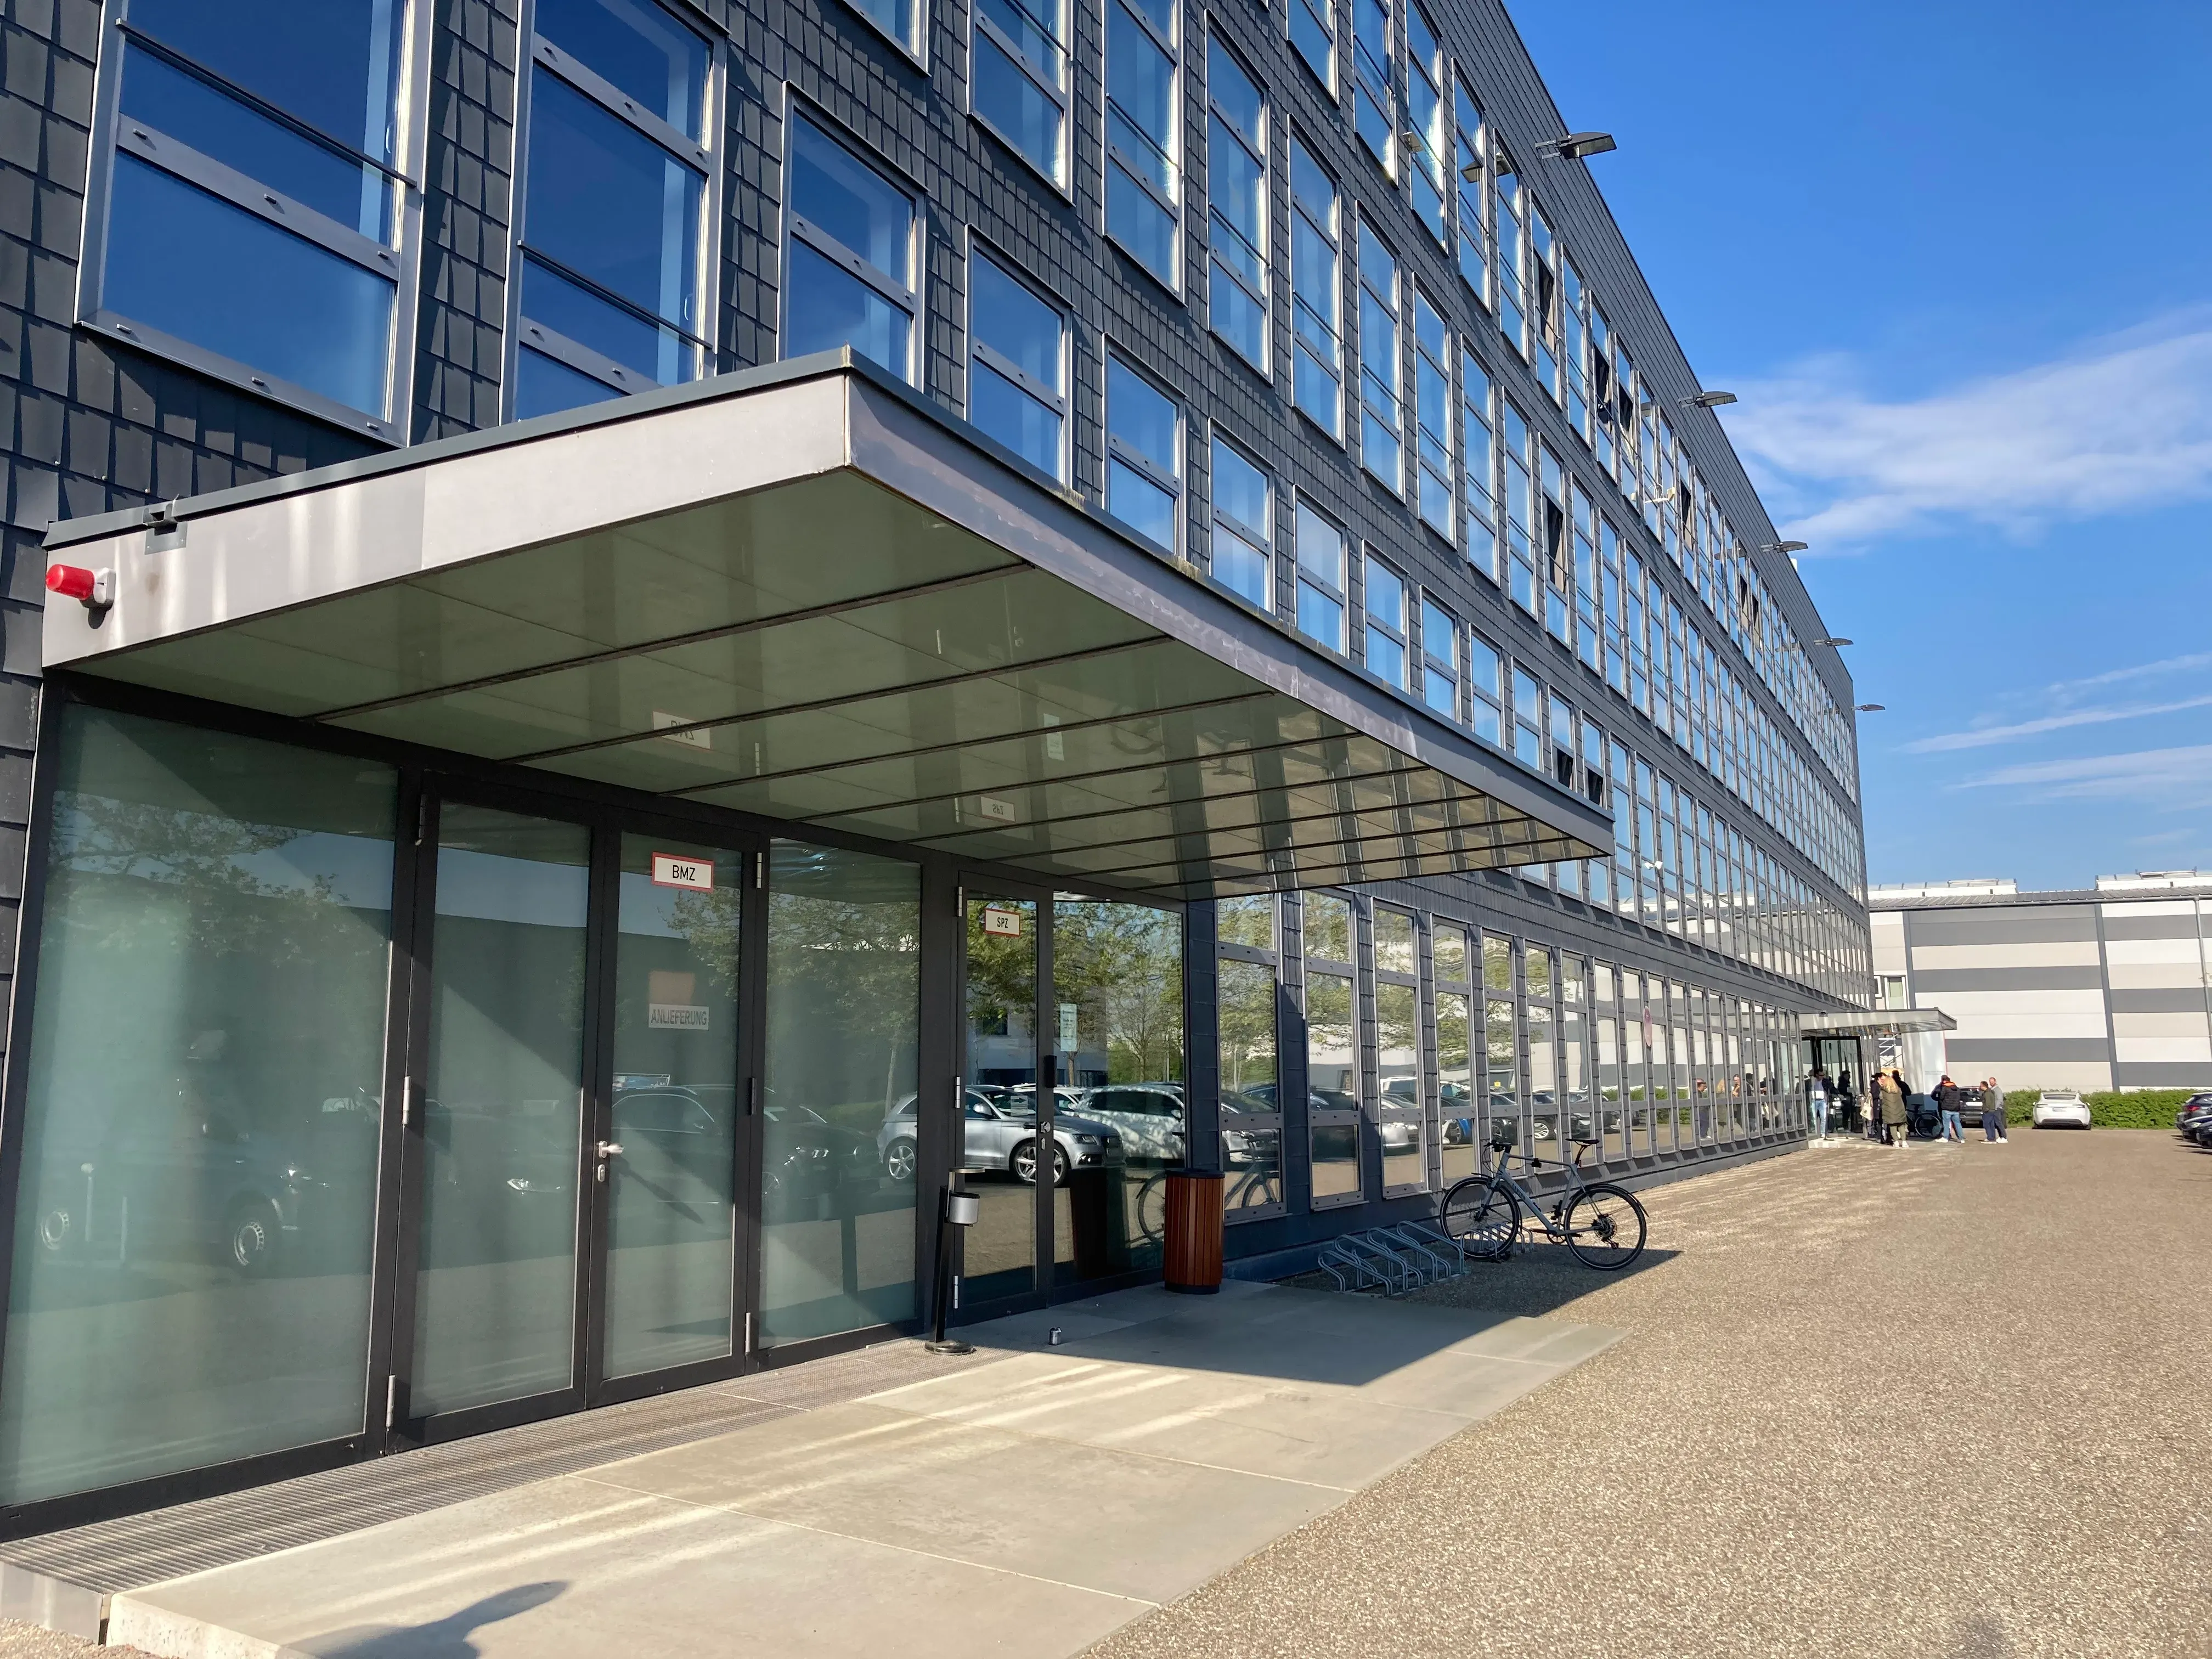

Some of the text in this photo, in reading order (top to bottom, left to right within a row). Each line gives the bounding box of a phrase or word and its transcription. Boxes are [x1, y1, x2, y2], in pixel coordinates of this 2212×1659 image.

[673, 865, 696, 881] BMZ
[997, 917, 1008, 928] SPZ
[651, 1009, 707, 1025] ANLIEFERUNG
